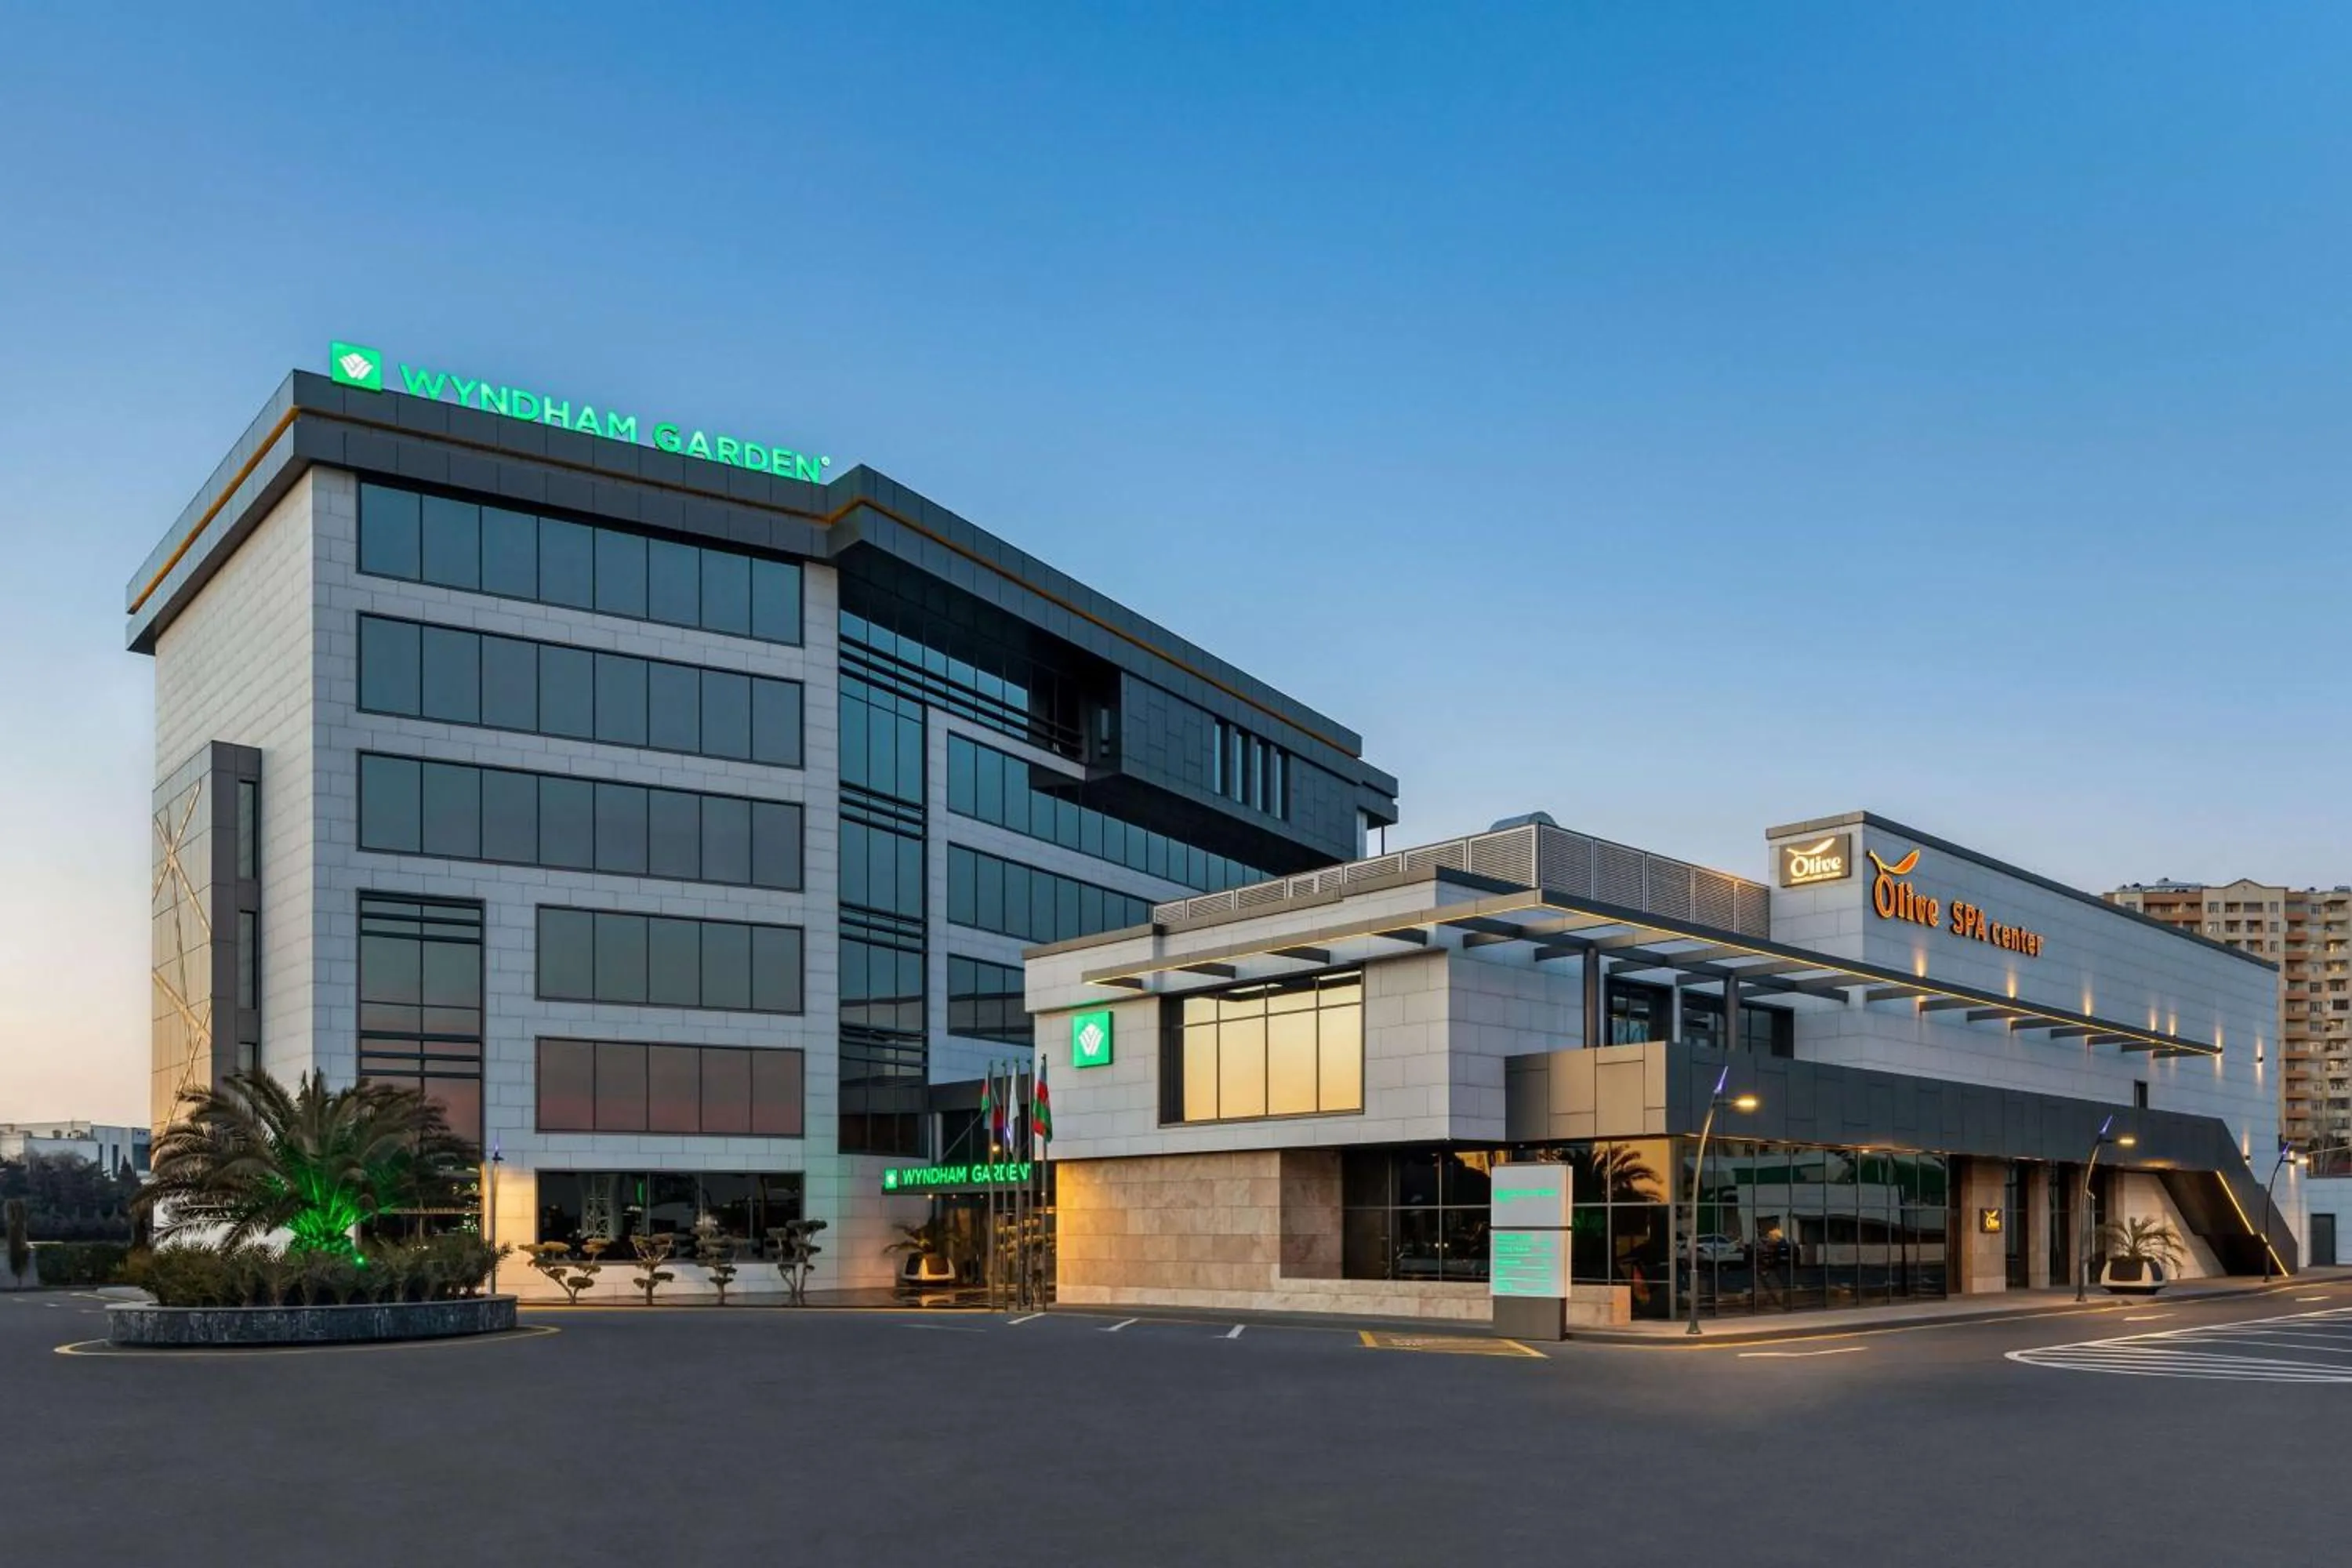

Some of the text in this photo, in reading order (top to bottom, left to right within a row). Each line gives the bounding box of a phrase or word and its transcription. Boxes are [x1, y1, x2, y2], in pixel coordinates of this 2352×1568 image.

[398, 362, 638, 445] WYNDHAM
[1790, 855, 1842, 877] Olive
[1872, 873, 2045, 957] Olive SPA center
[902, 1166, 967, 1186] WYNDHAM
